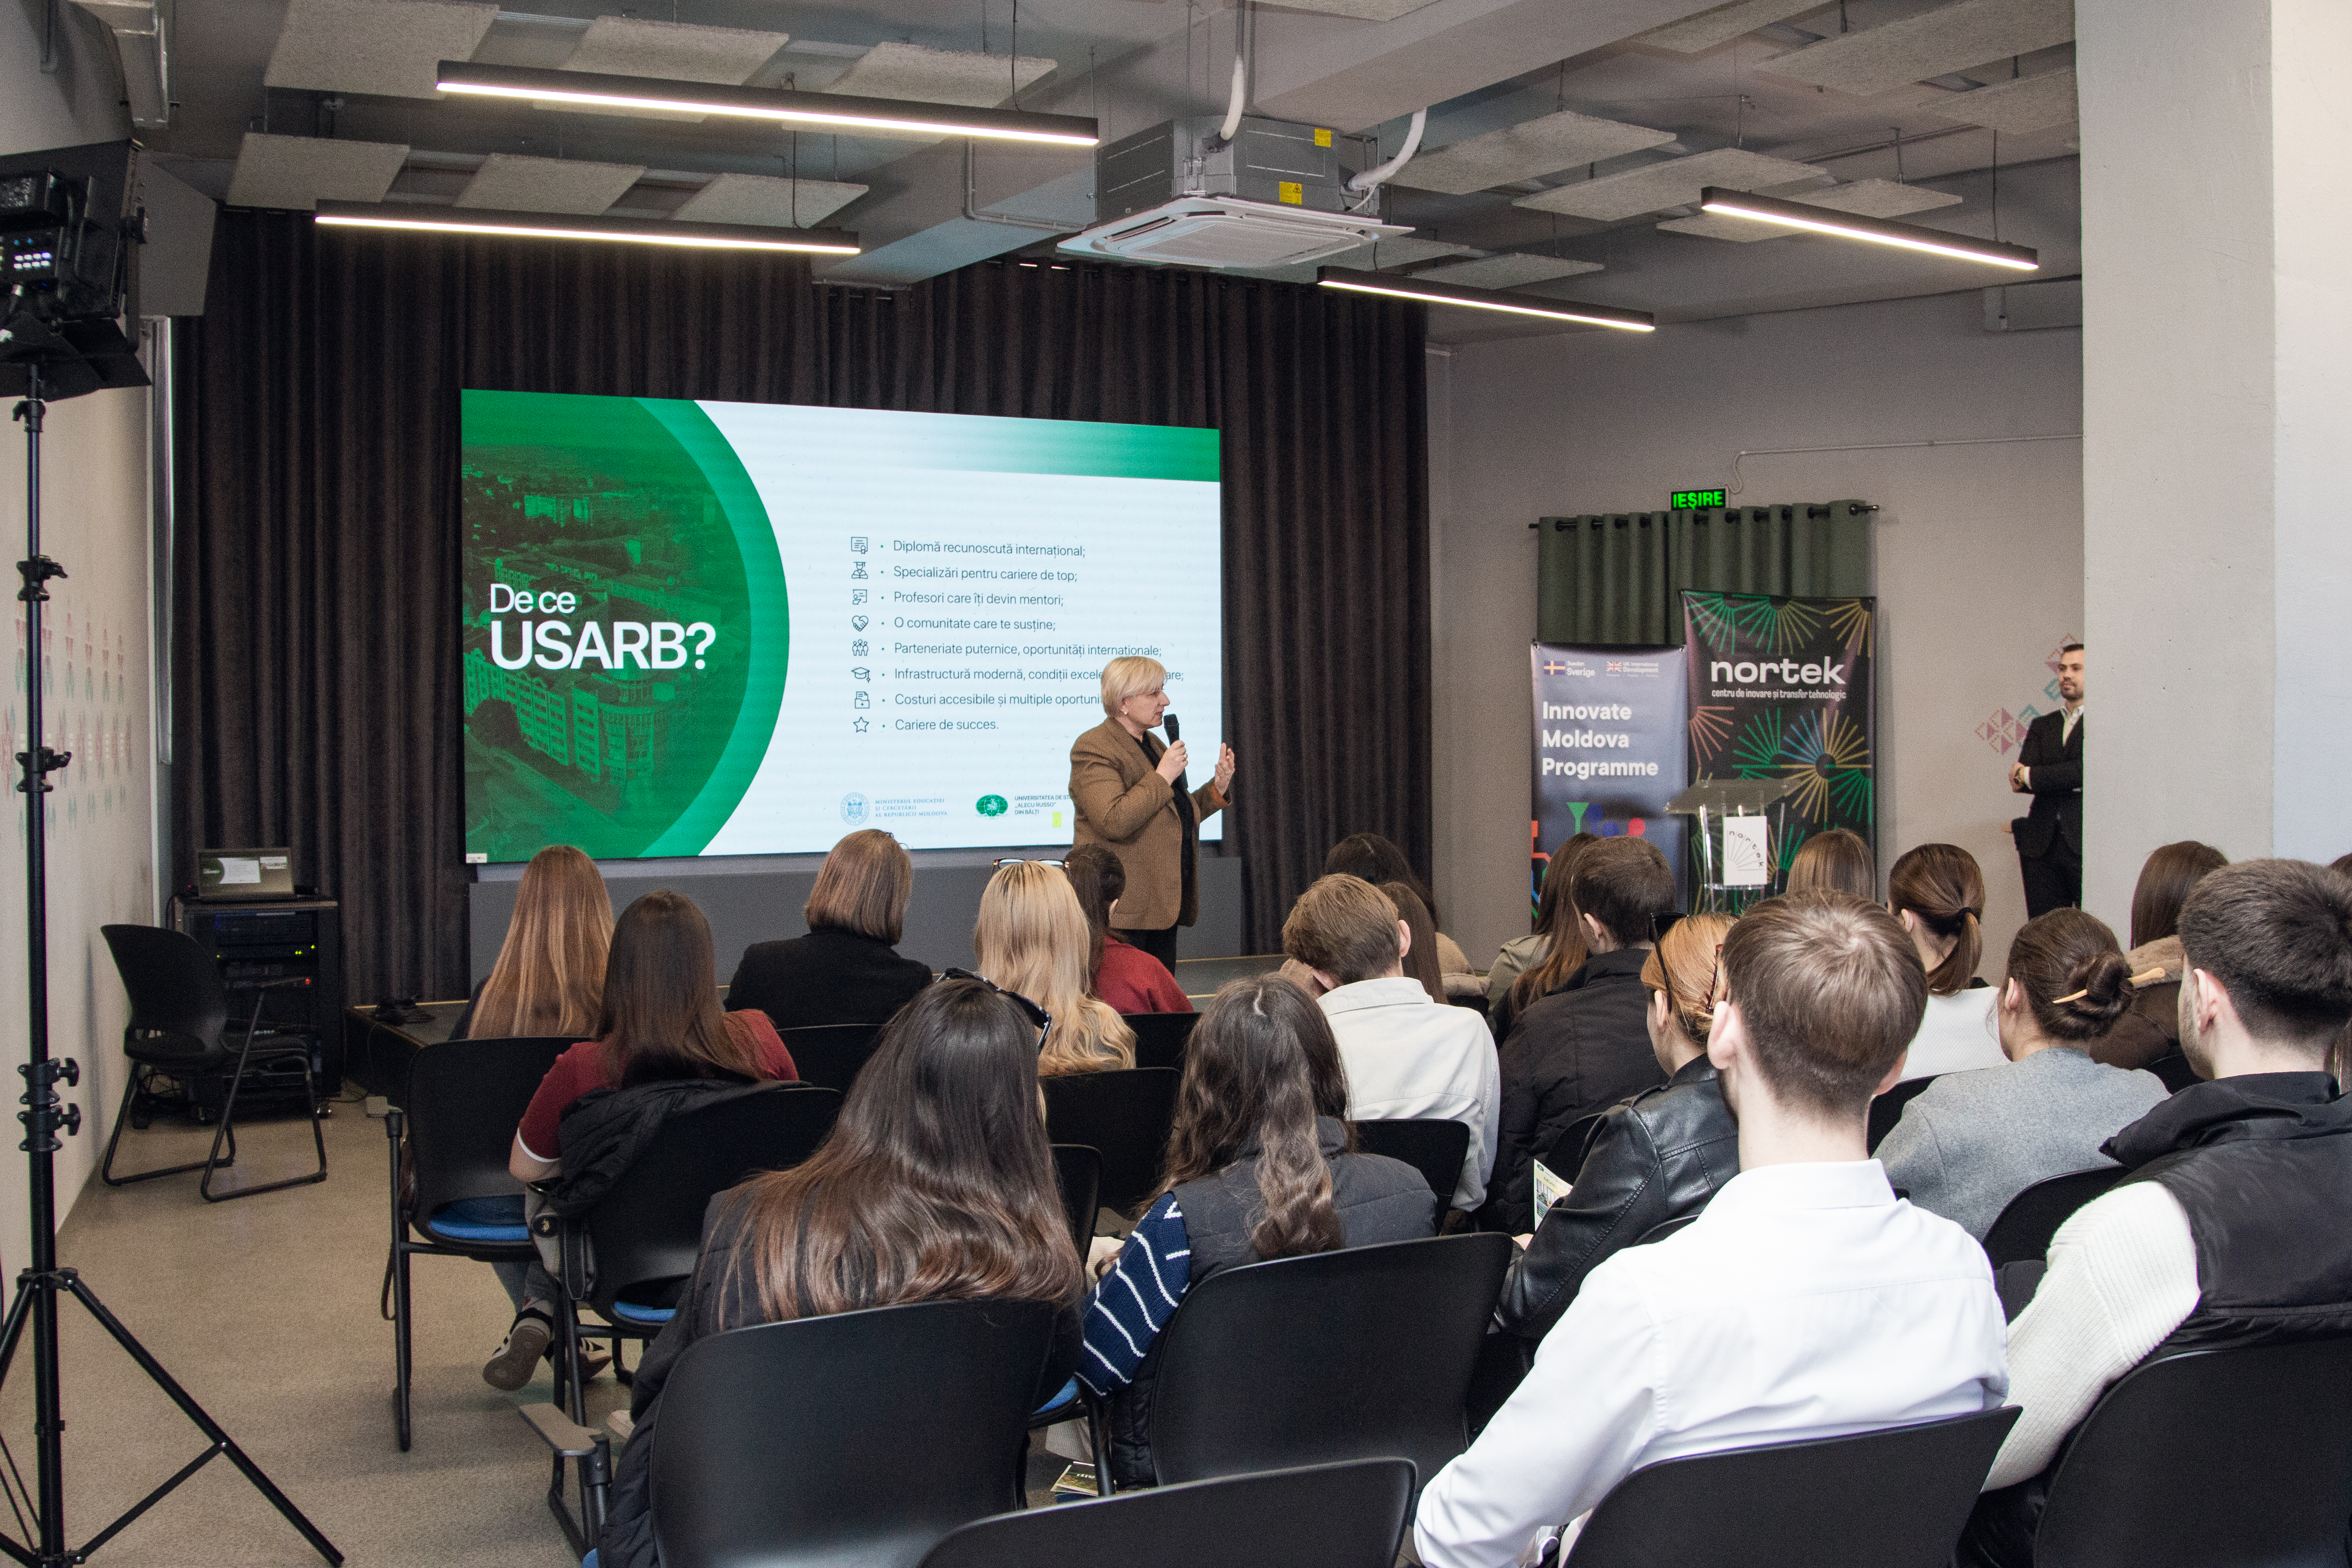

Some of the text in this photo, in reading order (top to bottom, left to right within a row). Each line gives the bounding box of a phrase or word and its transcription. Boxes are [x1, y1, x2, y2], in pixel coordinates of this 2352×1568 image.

[1673, 491, 1723, 510] IEȘIRE
[894, 540, 1086, 559] Diplomă recunoscută internațional;
[894, 566, 1078, 583] Specializări pentru cariere de top;
[490, 583, 576, 613] De ce
[894, 591, 1064, 607] Profesori care îți devin mentori;
[894, 617, 1056, 632] O comunitate care te susține;
[490, 620, 716, 670] USARB?
[895, 642, 1162, 658] Parteneriate puternice, oportunități internaționale;
[895, 668, 971, 680] Infrastructură
[974, 669, 1026, 681] modernă,
[1029, 669, 1068, 683] condiții
[1071, 669, 1102, 680] excele
[1566, 667, 1596, 677] Sverige
[1711, 656, 1847, 684] nortek
[895, 694, 1102, 708] Costuri accesibile și multiple oportuni
[1711, 689, 1735, 698] centru
[1736, 688, 1744, 697] de
[1745, 689, 1772, 698] inovare
[1780, 689, 1808, 699] transfer
[1808, 689, 1847, 701] tehnologic
[1543, 701, 1632, 720] Innovate
[895, 719, 999, 731] Cariere de succes.
[1543, 729, 1630, 748] Moldova
[1542, 757, 1659, 780] Programme
[1729, 830, 1764, 867] nortek
